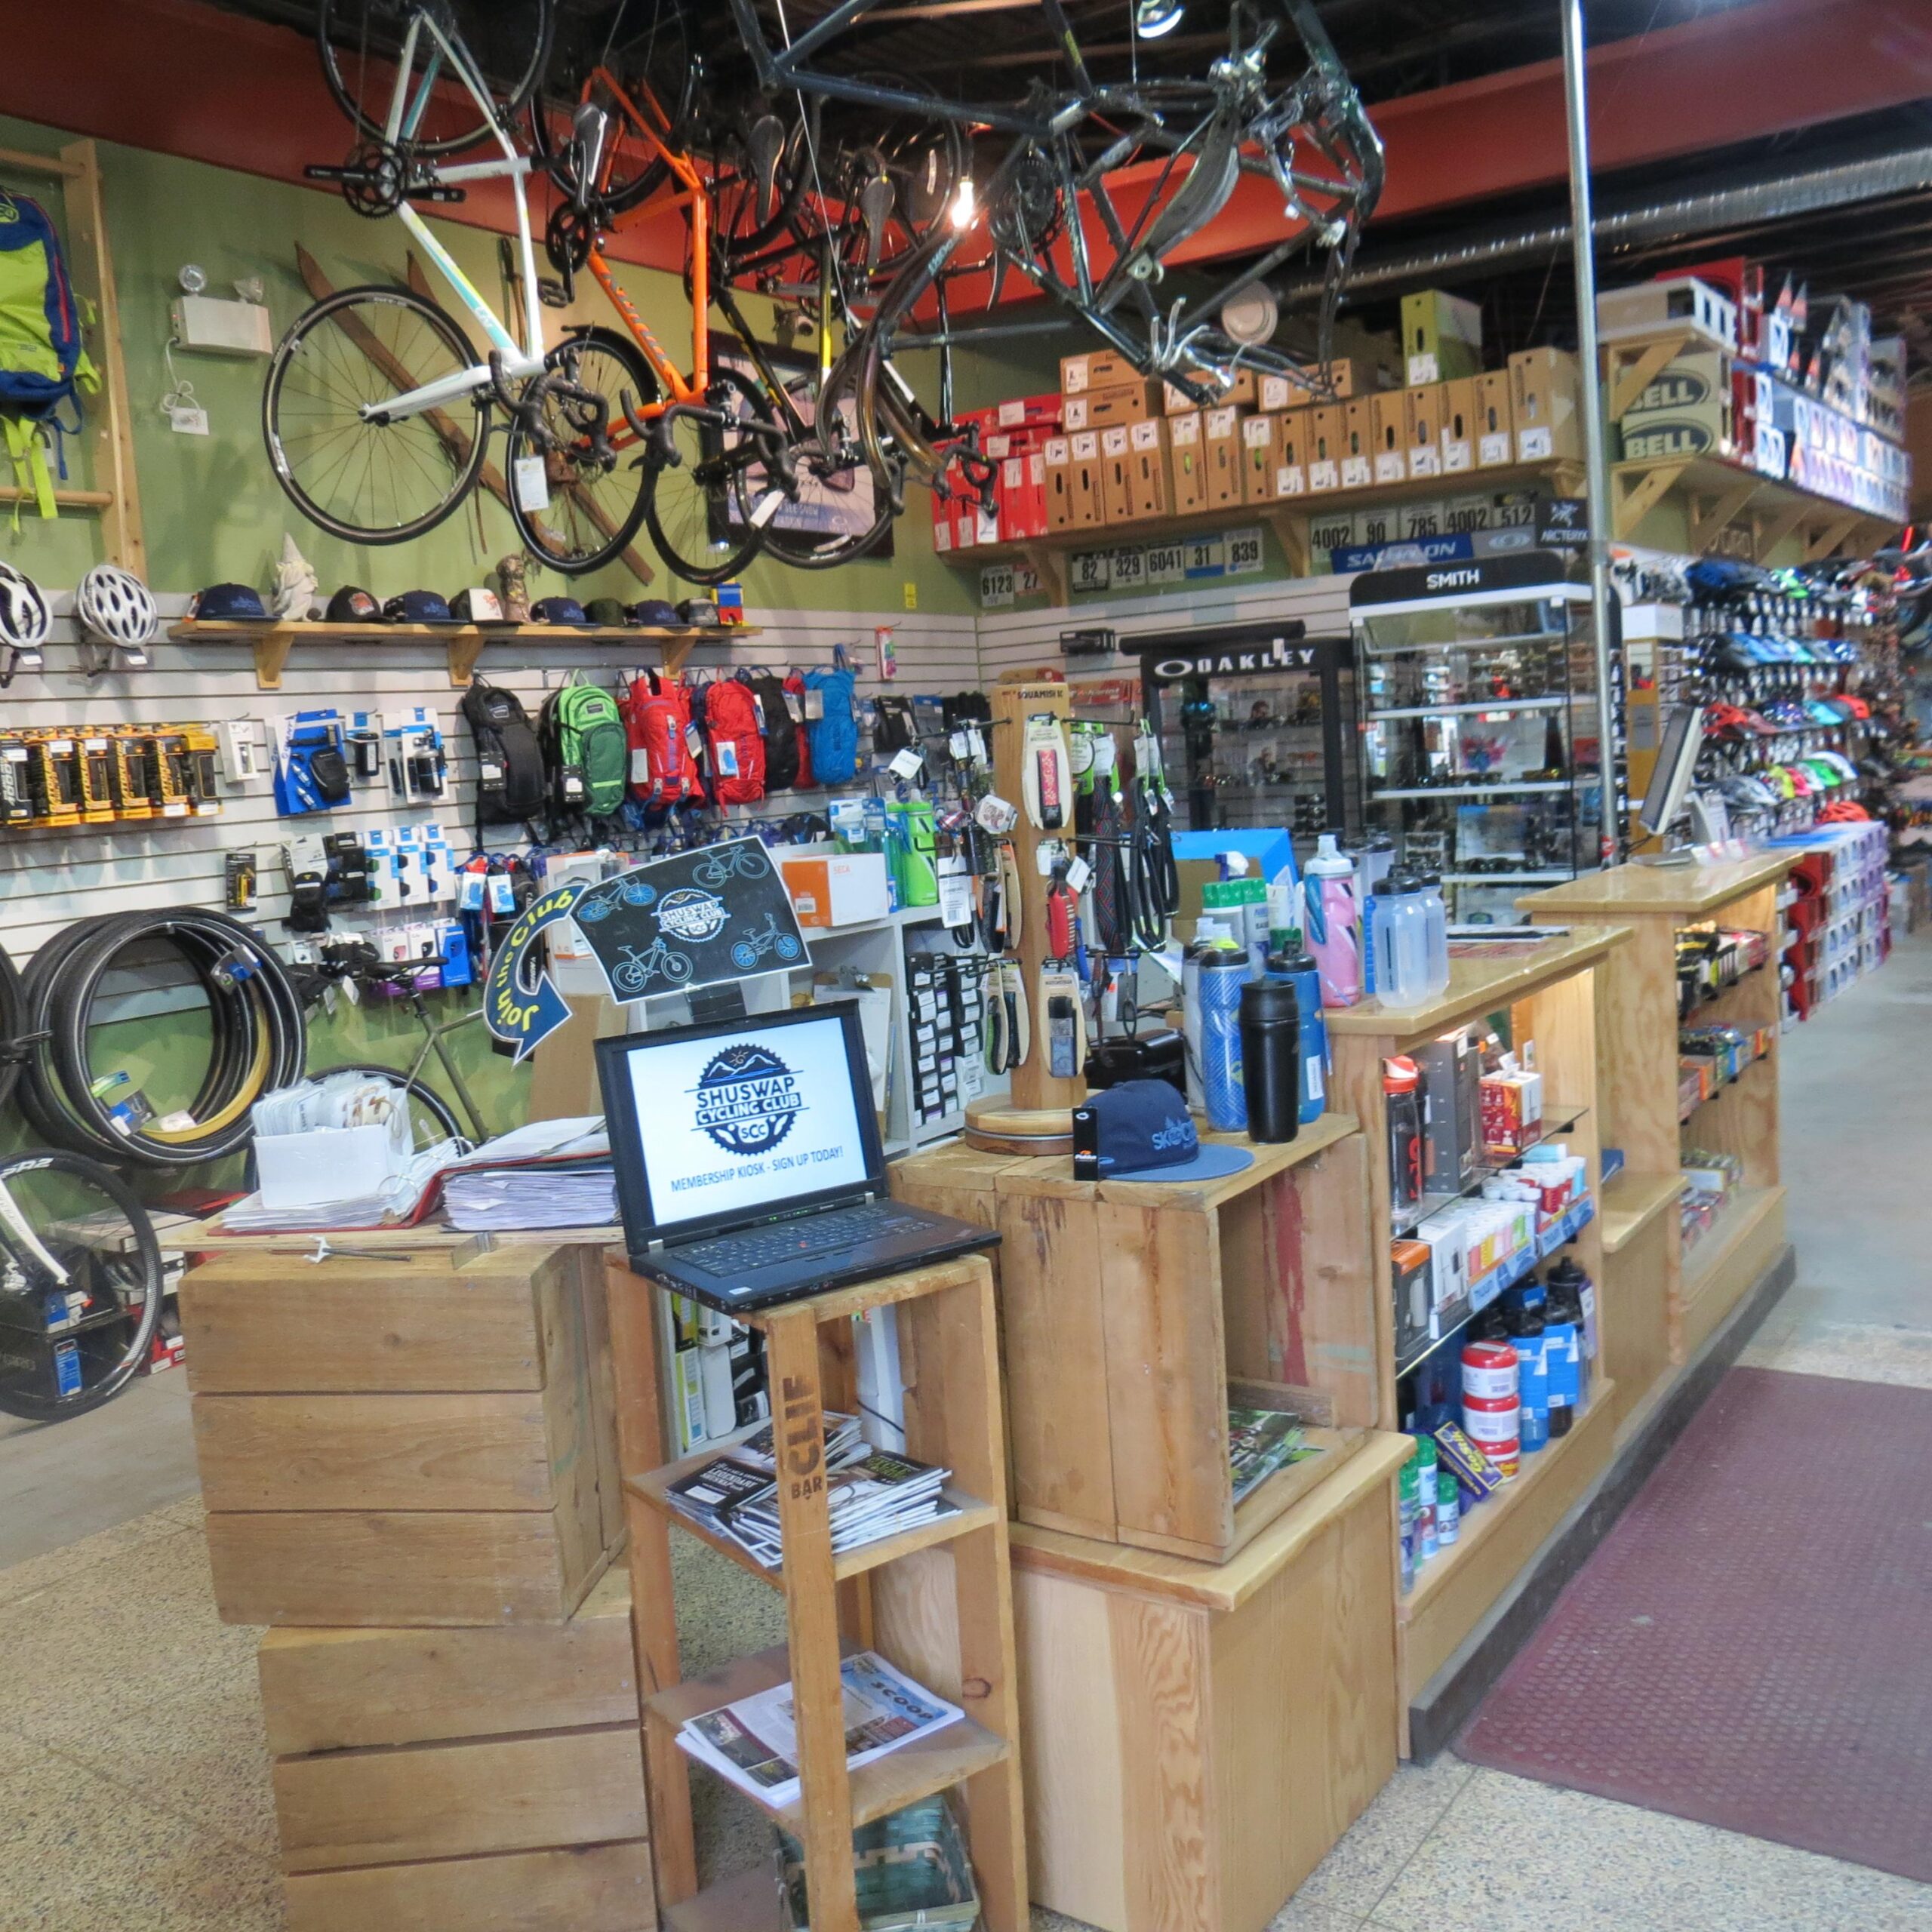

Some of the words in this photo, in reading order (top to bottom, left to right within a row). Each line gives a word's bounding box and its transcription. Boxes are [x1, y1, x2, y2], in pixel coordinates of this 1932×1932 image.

[1626, 430, 1699, 458] BELL
[1408, 515, 1437, 540] 785
[1447, 508, 1487, 534] 4002
[1501, 505, 1531, 529] 512
[1312, 527, 1350, 549] 4002
[1366, 521, 1386, 544] 90
[1149, 550, 1181, 572] 6041
[1195, 546, 1211, 565] 31
[1232, 541, 1258, 562] 839
[1081, 561, 1097, 580] 82
[1116, 555, 1140, 577] 329
[983, 574, 1013, 595] 6123
[1426, 568, 1481, 589] SMITH
[1198, 649, 1315, 674] OAKLEY
[510, 889, 574, 948] Club
[660, 900, 718, 921] SHUSWAP
[662, 915, 700, 928] CYCLING
[700, 908, 724, 920] CLUB
[496, 950, 515, 987] the
[497, 989, 540, 1032] Join
[696, 1076, 796, 1108] SHUSWAP
[697, 1100, 759, 1124] CYCLING
[763, 1094, 800, 1111] CLUB
[671, 1169, 735, 1192] MEMBERSHIP
[737, 1161, 766, 1180] KIOSK
[772, 1155, 793, 1172] SIGN
[795, 1153, 809, 1166] UP
[811, 1145, 844, 1164] TODAY!
[783, 1377, 821, 1475] CLIF
[790, 1476, 823, 1499] BAR
[870, 1681, 934, 1720] SCOOP
